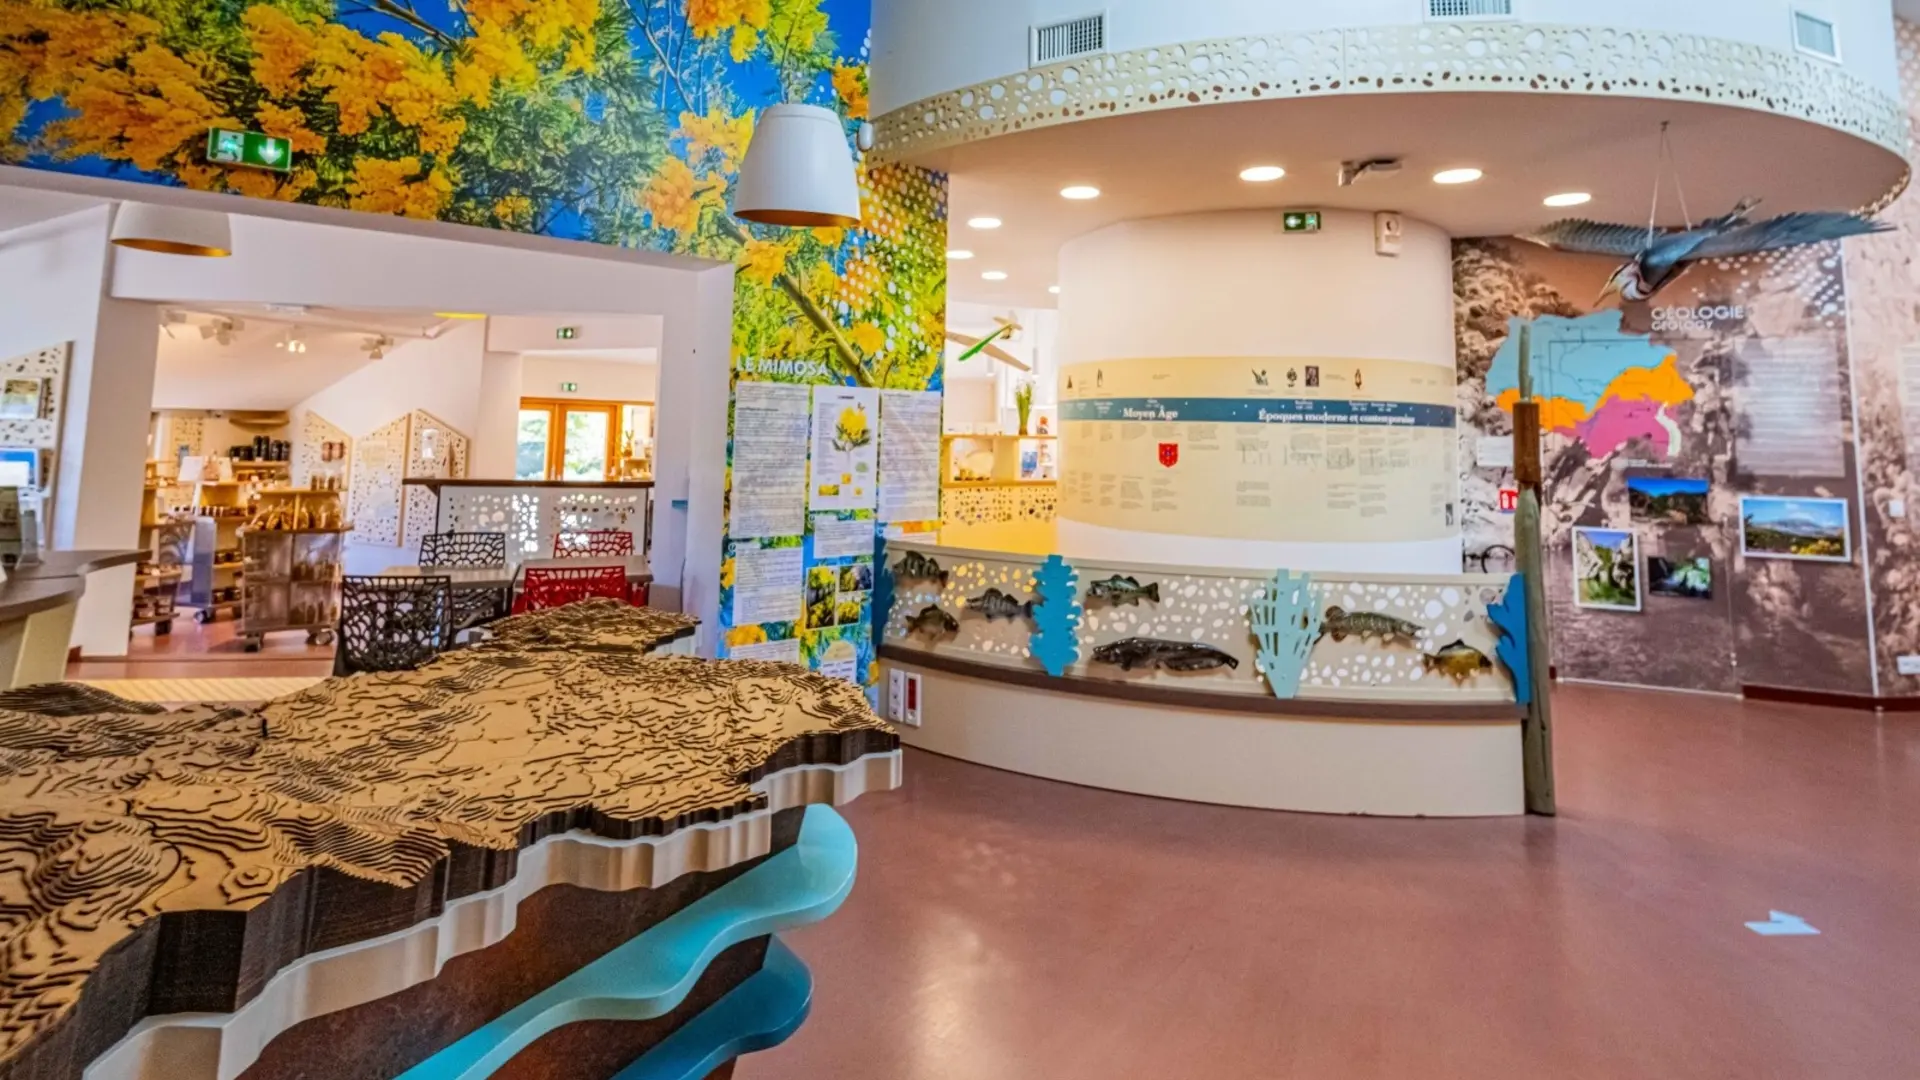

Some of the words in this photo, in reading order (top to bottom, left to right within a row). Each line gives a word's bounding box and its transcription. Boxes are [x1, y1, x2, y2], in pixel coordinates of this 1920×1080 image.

[736, 356, 755, 372] LE
[758, 358, 829, 376] MIMOSA
[1123, 408, 1156, 420] Moyen
[1158, 405, 1178, 421] Âge
[1258, 408, 1303, 423] Époques
[1305, 412, 1348, 423] moderne
[1349, 412, 1359, 423] et
